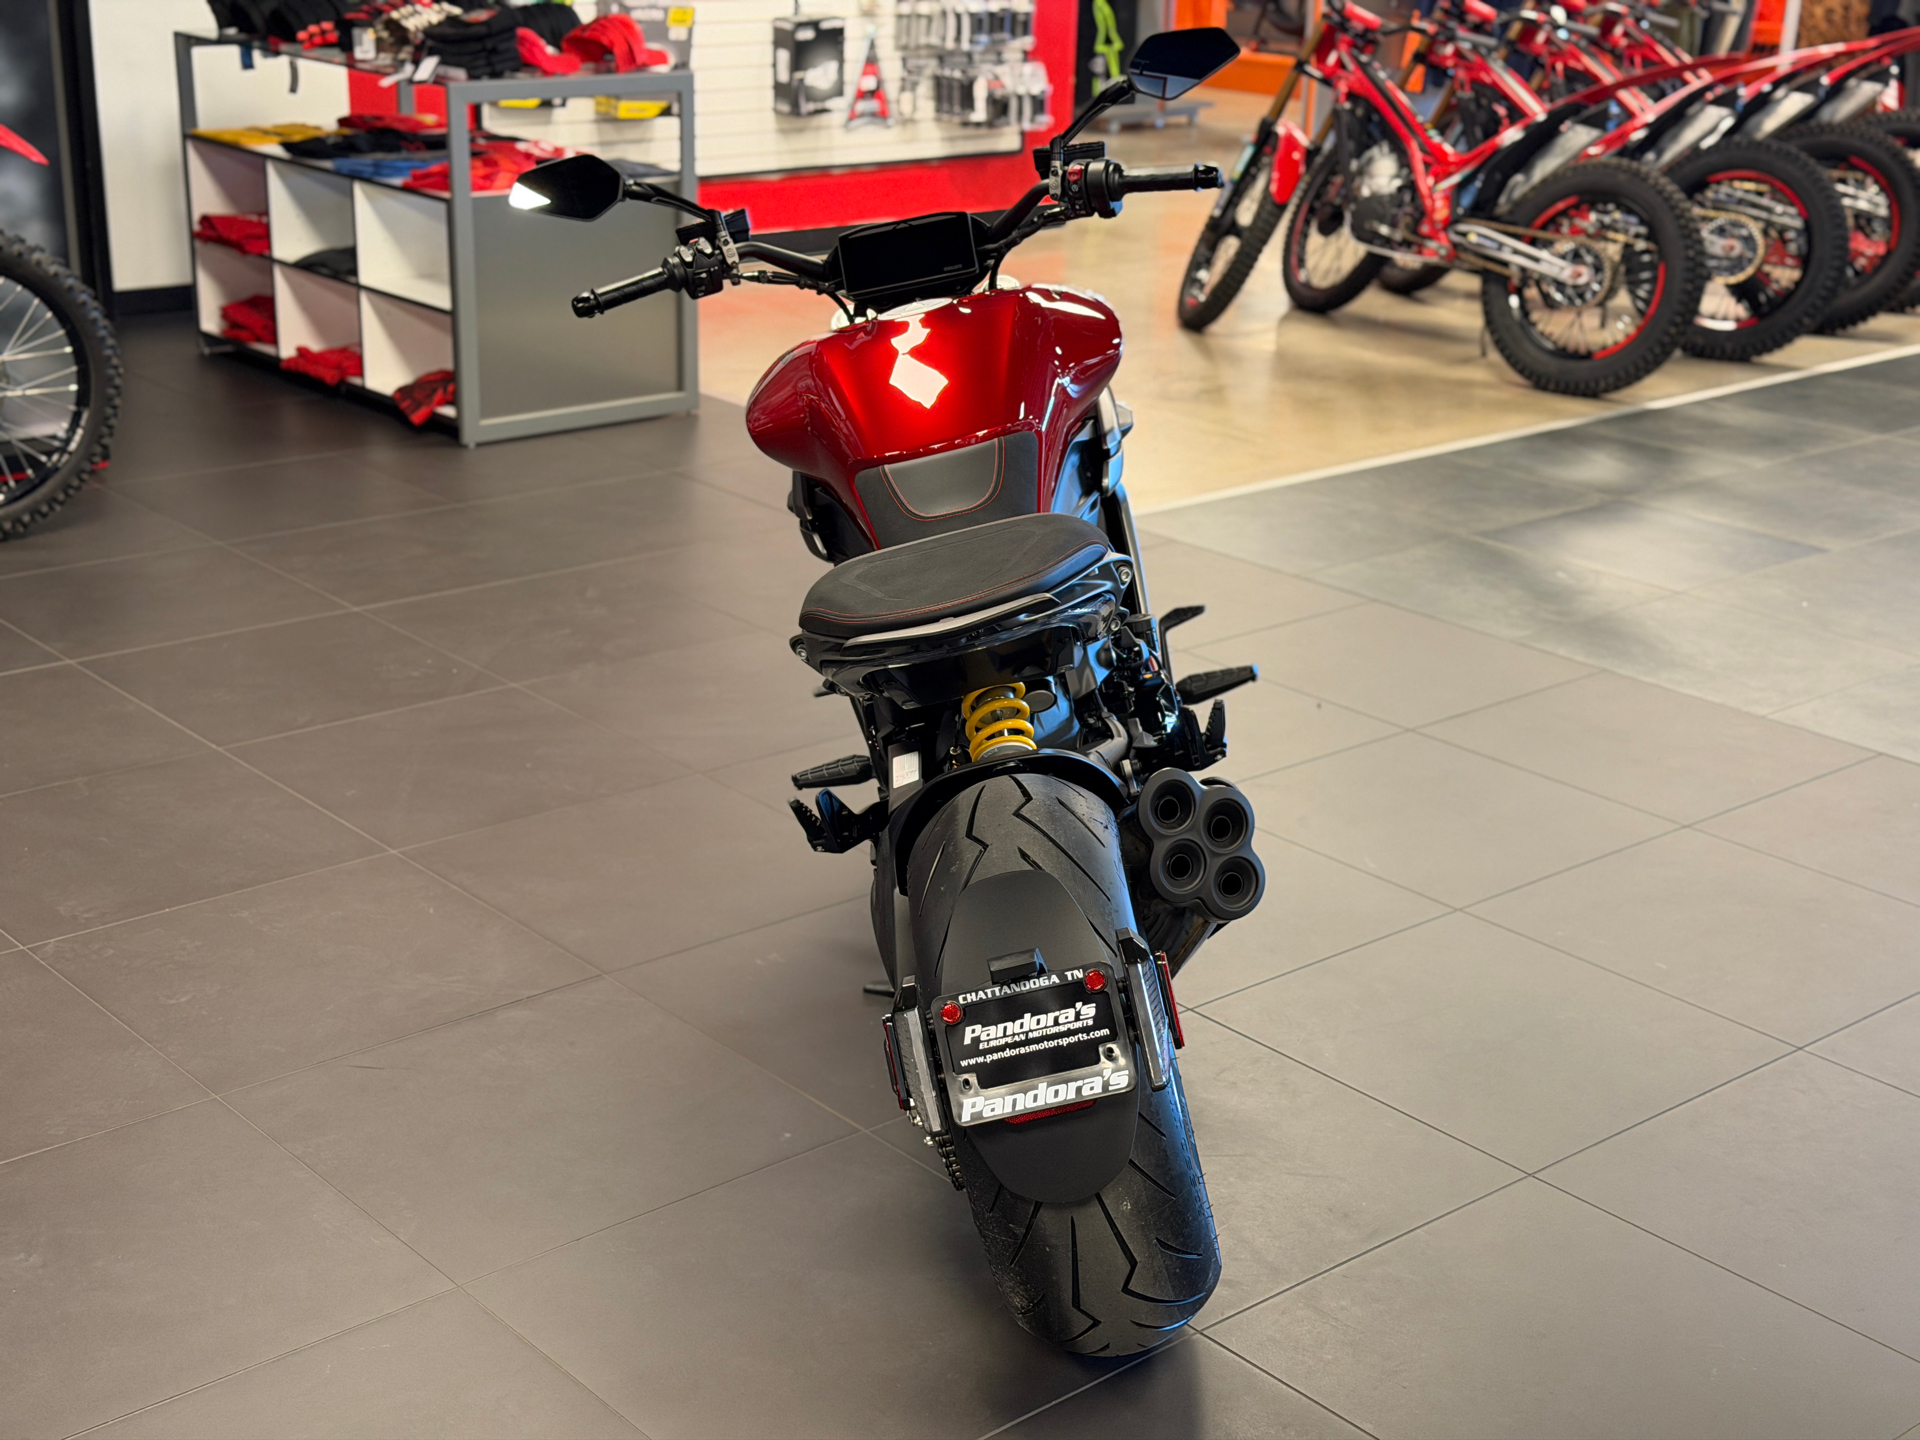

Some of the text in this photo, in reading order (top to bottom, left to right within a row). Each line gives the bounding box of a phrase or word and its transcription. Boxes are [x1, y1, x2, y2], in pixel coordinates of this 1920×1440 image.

[958, 969, 1084, 1005] CHATTANOOGA TN
[963, 1001, 1097, 1045] Pandora's
[979, 1018, 1094, 1050] EUROPEAN MOTORSPORTS
[959, 1027, 1110, 1068] www.pandorasmotorsports.com
[961, 1068, 1130, 1122] Pandora's
